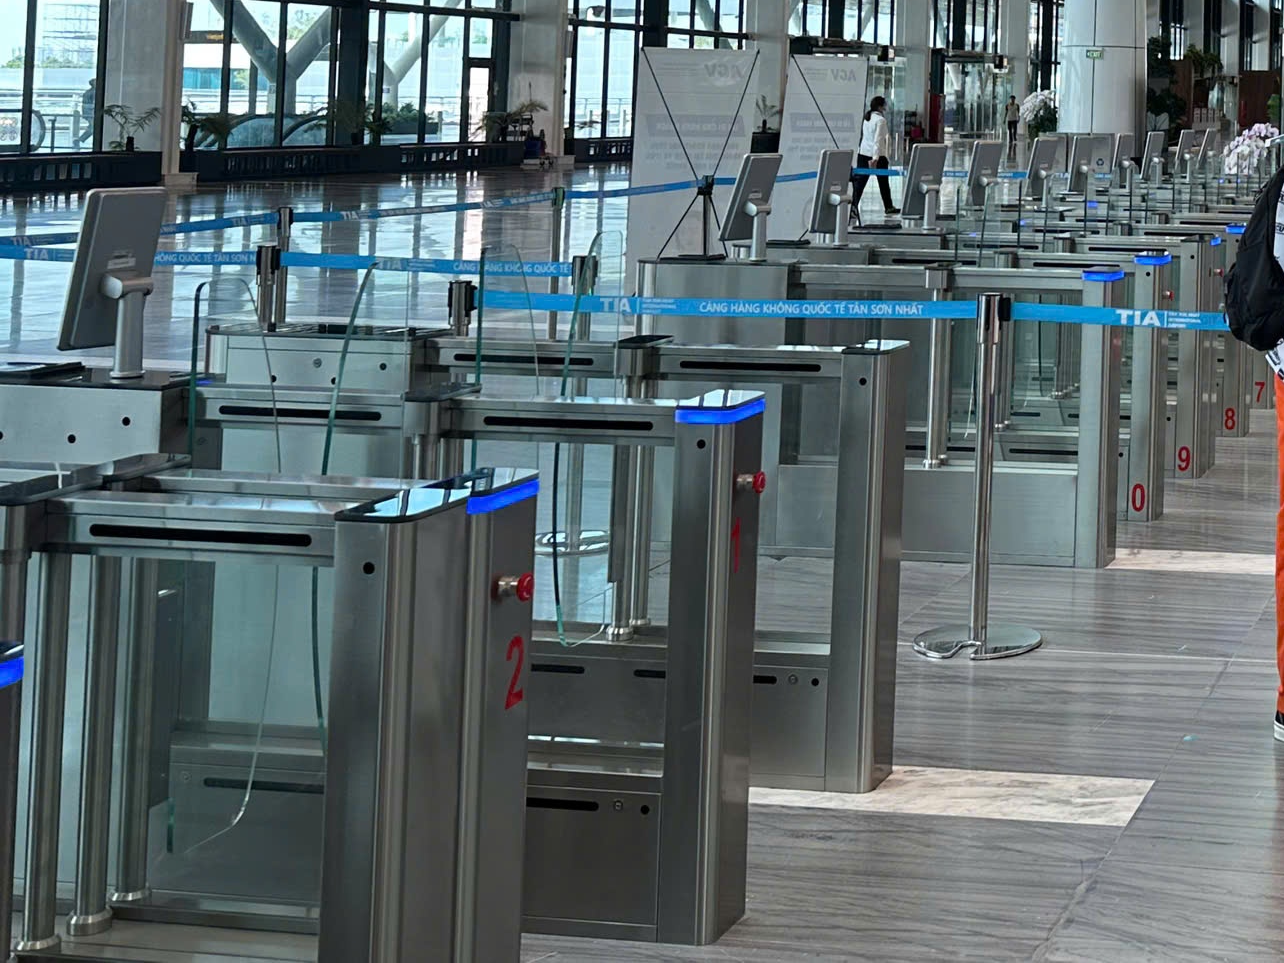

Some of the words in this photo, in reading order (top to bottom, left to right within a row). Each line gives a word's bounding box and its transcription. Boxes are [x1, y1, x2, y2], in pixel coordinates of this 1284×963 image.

[24, 248, 49, 259] TIA
[602, 298, 631, 313] TIA
[700, 301, 728, 313] CẢNG
[731, 301, 760, 314] HÀNG
[763, 301, 800, 315] KHÔNG
[803, 301, 831, 315] QUỐC
[835, 302, 846, 315] TẾ
[848, 302, 868, 315] TÂN
[871, 303, 893, 315] SƠN
[896, 303, 924, 316] NHẤT
[1115, 310, 1161, 327] TIA
[1254, 381, 1266, 403] 7
[1224, 407, 1236, 431] 8
[1177, 445, 1191, 472] 9
[1131, 483, 1146, 513] 0
[504, 636, 525, 710] 2
